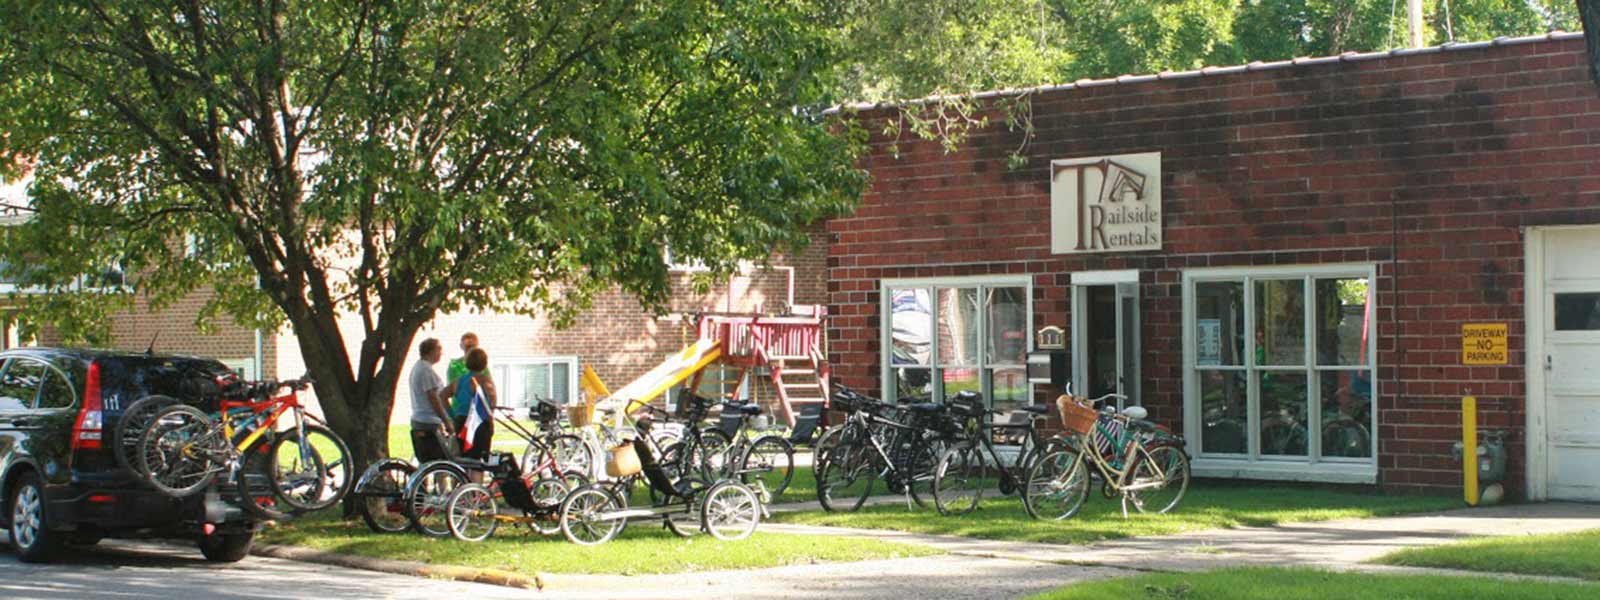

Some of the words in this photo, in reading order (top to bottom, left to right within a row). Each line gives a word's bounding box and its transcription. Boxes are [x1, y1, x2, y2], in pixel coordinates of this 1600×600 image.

[1463, 328, 1505, 337] DRIVEWAY
[1477, 339, 1493, 350] NO
[1466, 351, 1504, 361] PARKING
